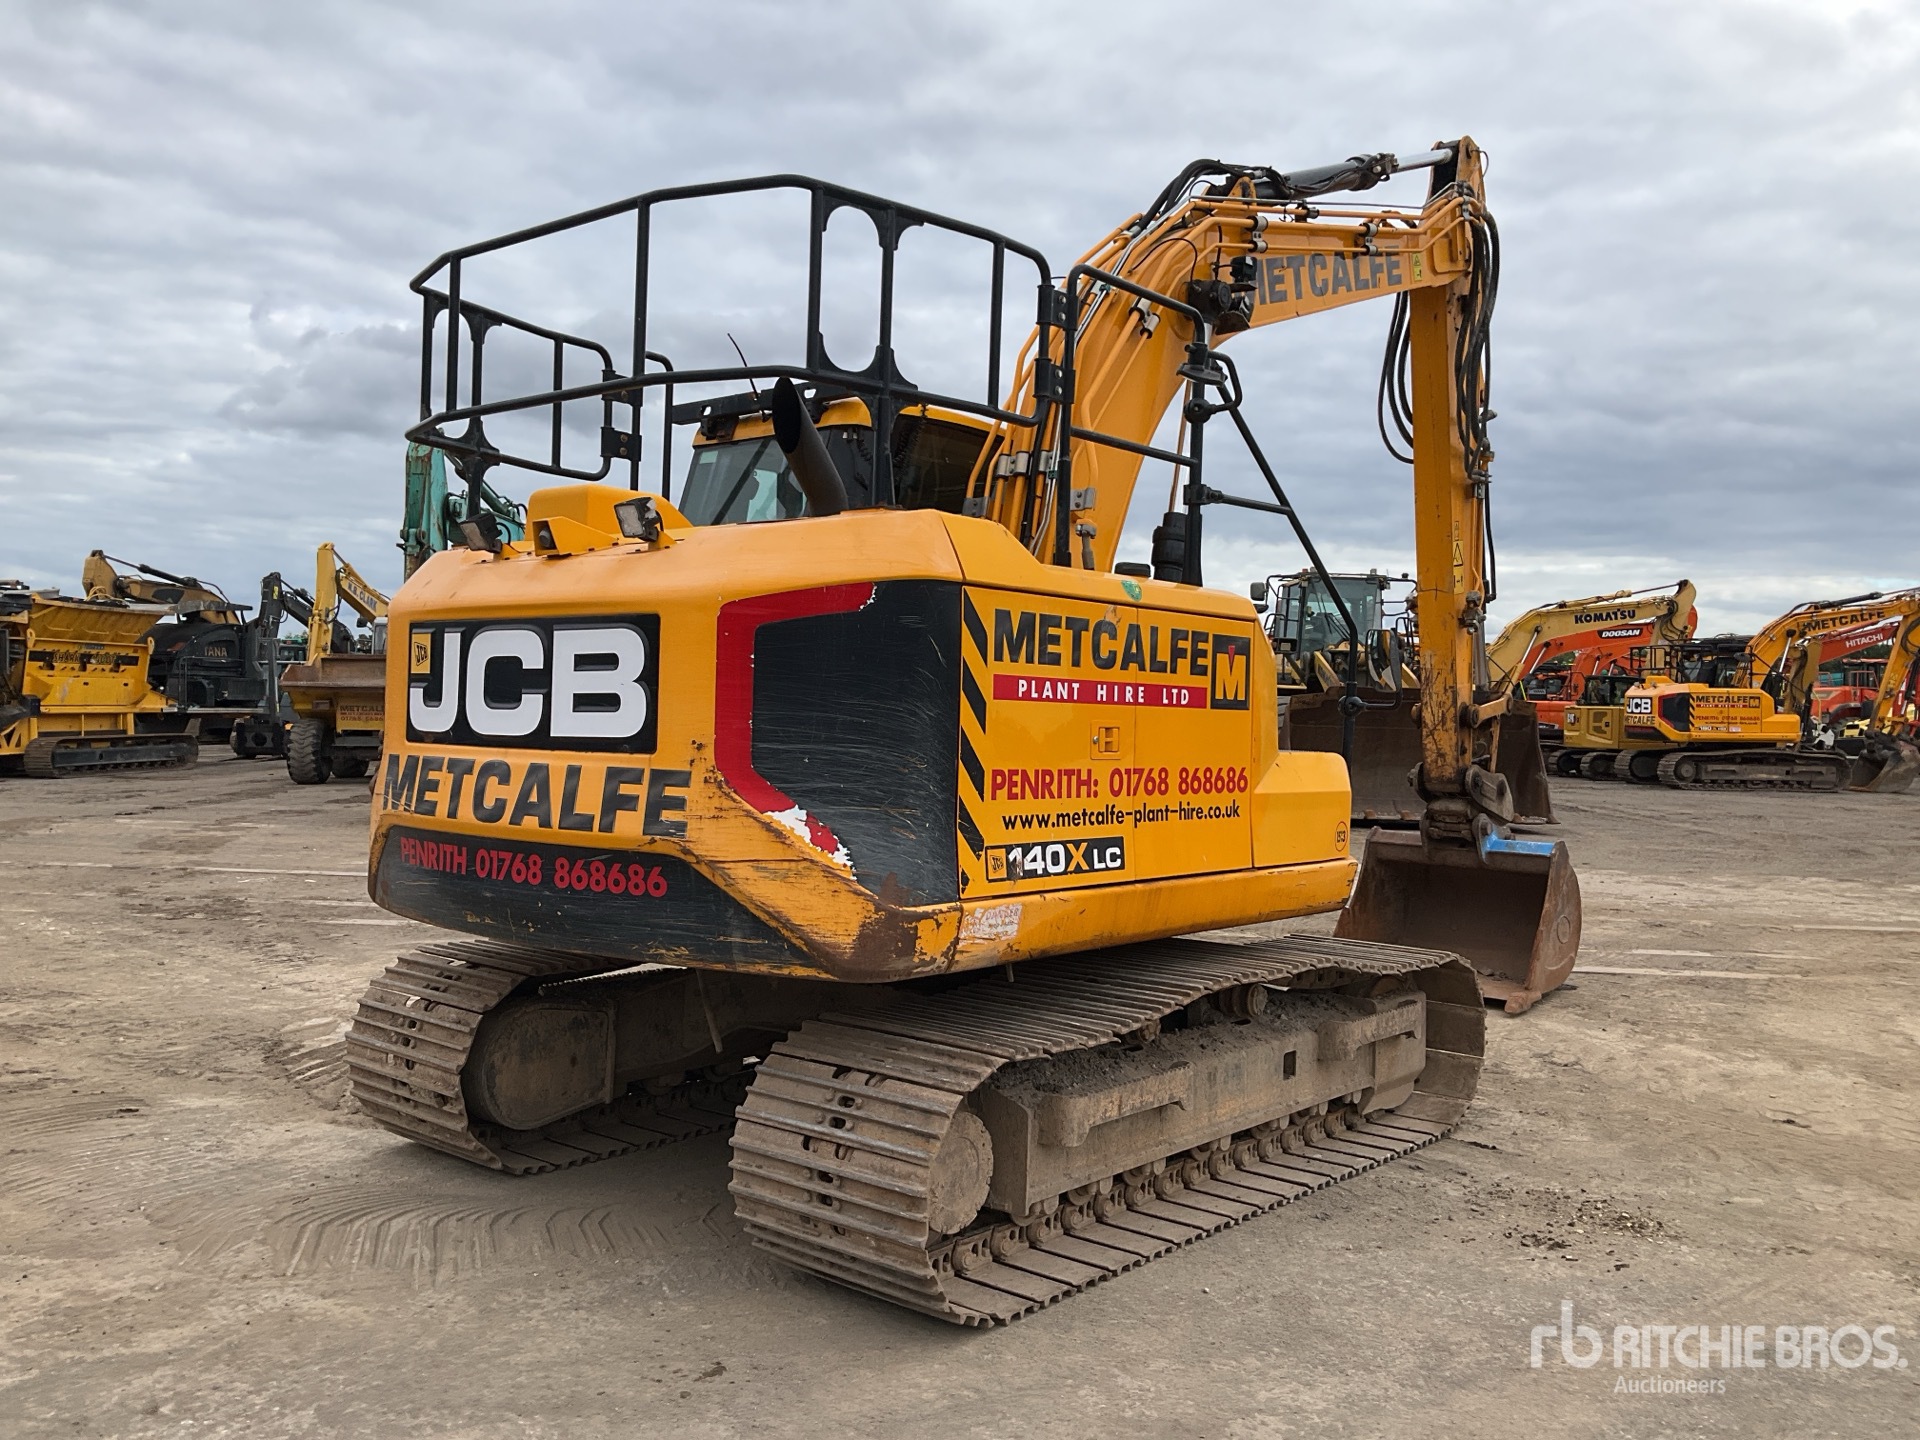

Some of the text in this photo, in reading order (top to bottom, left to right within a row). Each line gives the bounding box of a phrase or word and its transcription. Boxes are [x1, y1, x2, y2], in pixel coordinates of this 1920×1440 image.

[1574, 608, 1636, 624] KOMATSU
[1807, 611, 1885, 631] METCALFE
[994, 608, 1209, 676] METCALFE
[1602, 629, 1640, 638] DOOSAN
[1846, 633, 1883, 648] HITACHI
[415, 642, 429, 665] JCB
[409, 628, 647, 738] JCB
[1018, 680, 1190, 705] PLANT HIRE LTD
[1626, 698, 1651, 713] JCB
[990, 766, 1249, 801] PENRITH: 01768 868686
[383, 754, 691, 838] METCALFE
[1001, 799, 1241, 830] www.metcalfe-plant-hire.co.uk
[400, 836, 668, 898] PENRITH 01768 868686
[1093, 847, 1122, 869] LC
